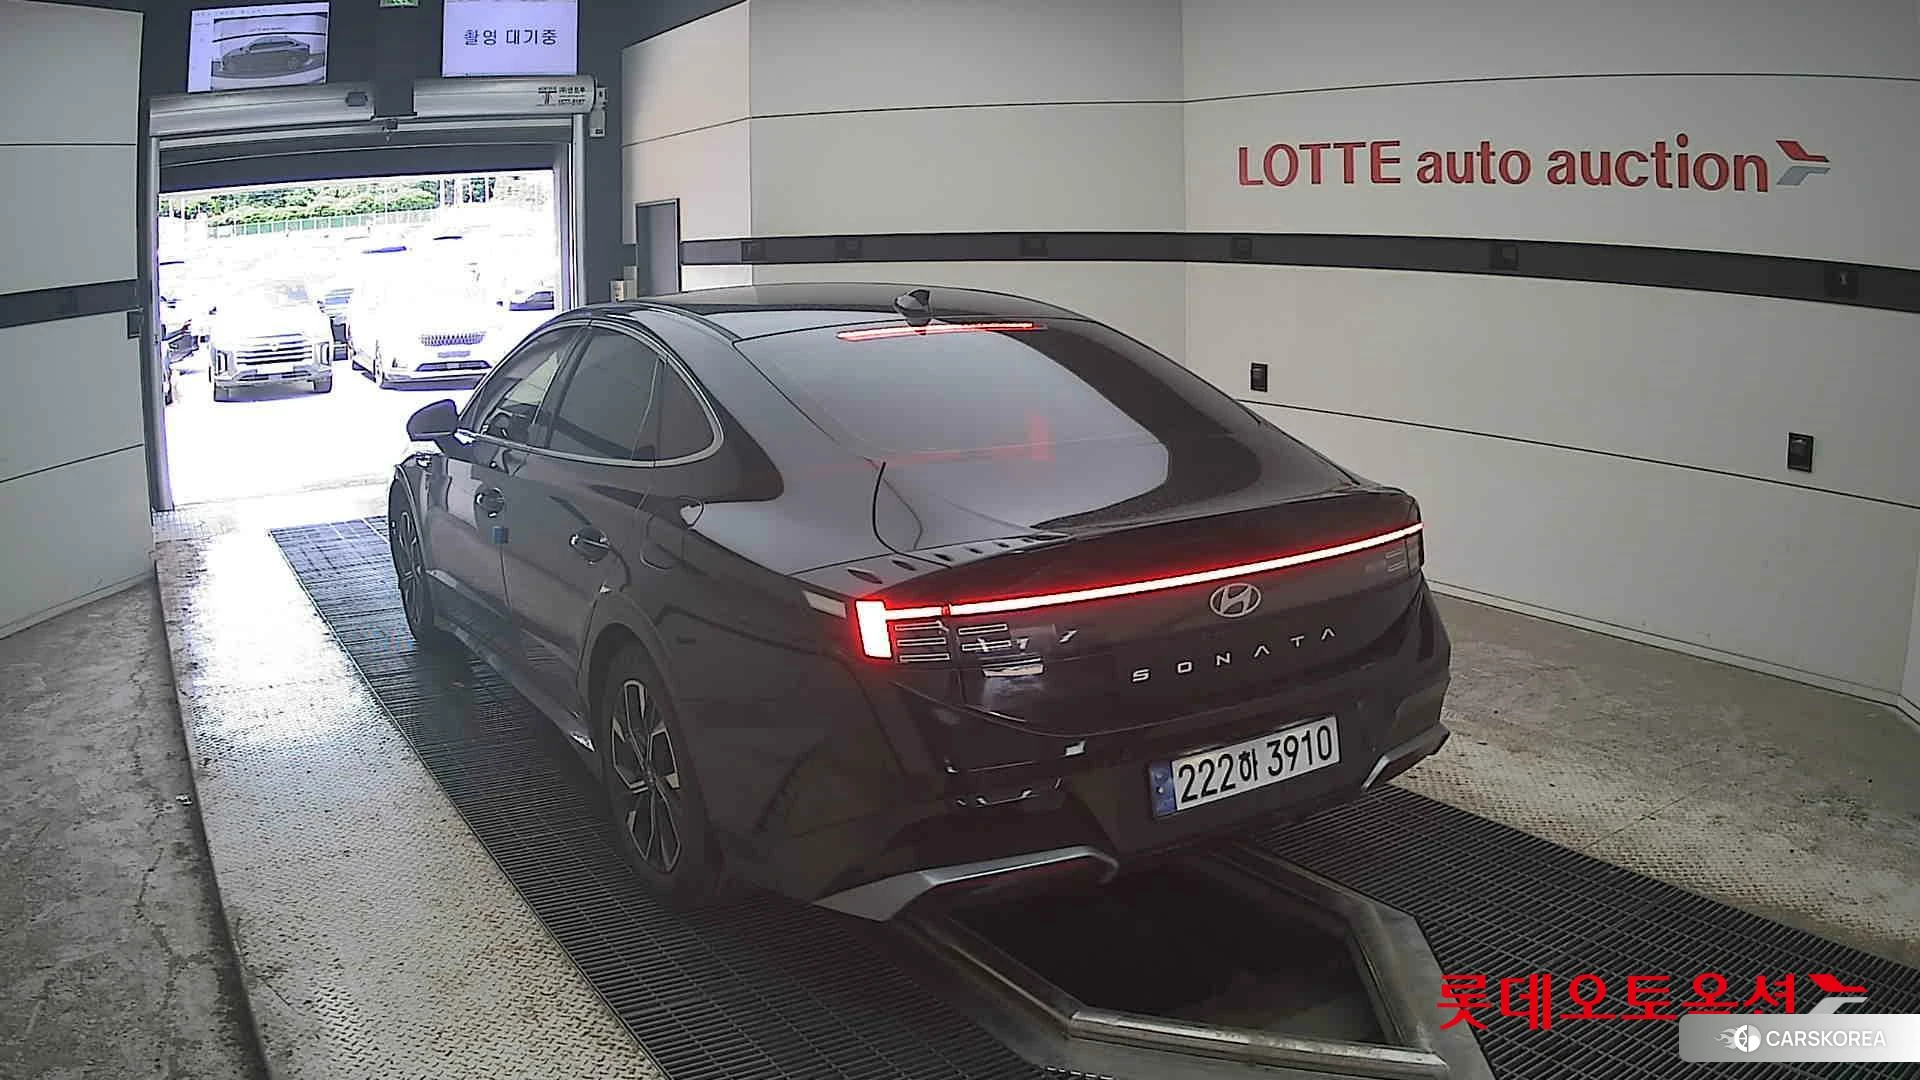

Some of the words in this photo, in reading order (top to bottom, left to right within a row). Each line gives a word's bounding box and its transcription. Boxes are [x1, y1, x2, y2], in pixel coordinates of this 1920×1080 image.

[463, 29, 497, 46] 촬영
[505, 29, 558, 46] 대기중
[1238, 140, 1401, 188] LOTTE
[1416, 140, 1532, 186] auto
[1547, 133, 1769, 193] auction
[1132, 627, 1336, 683] SONATA
[1178, 748, 1259, 804] 222하
[1266, 725, 1333, 777] 3910
